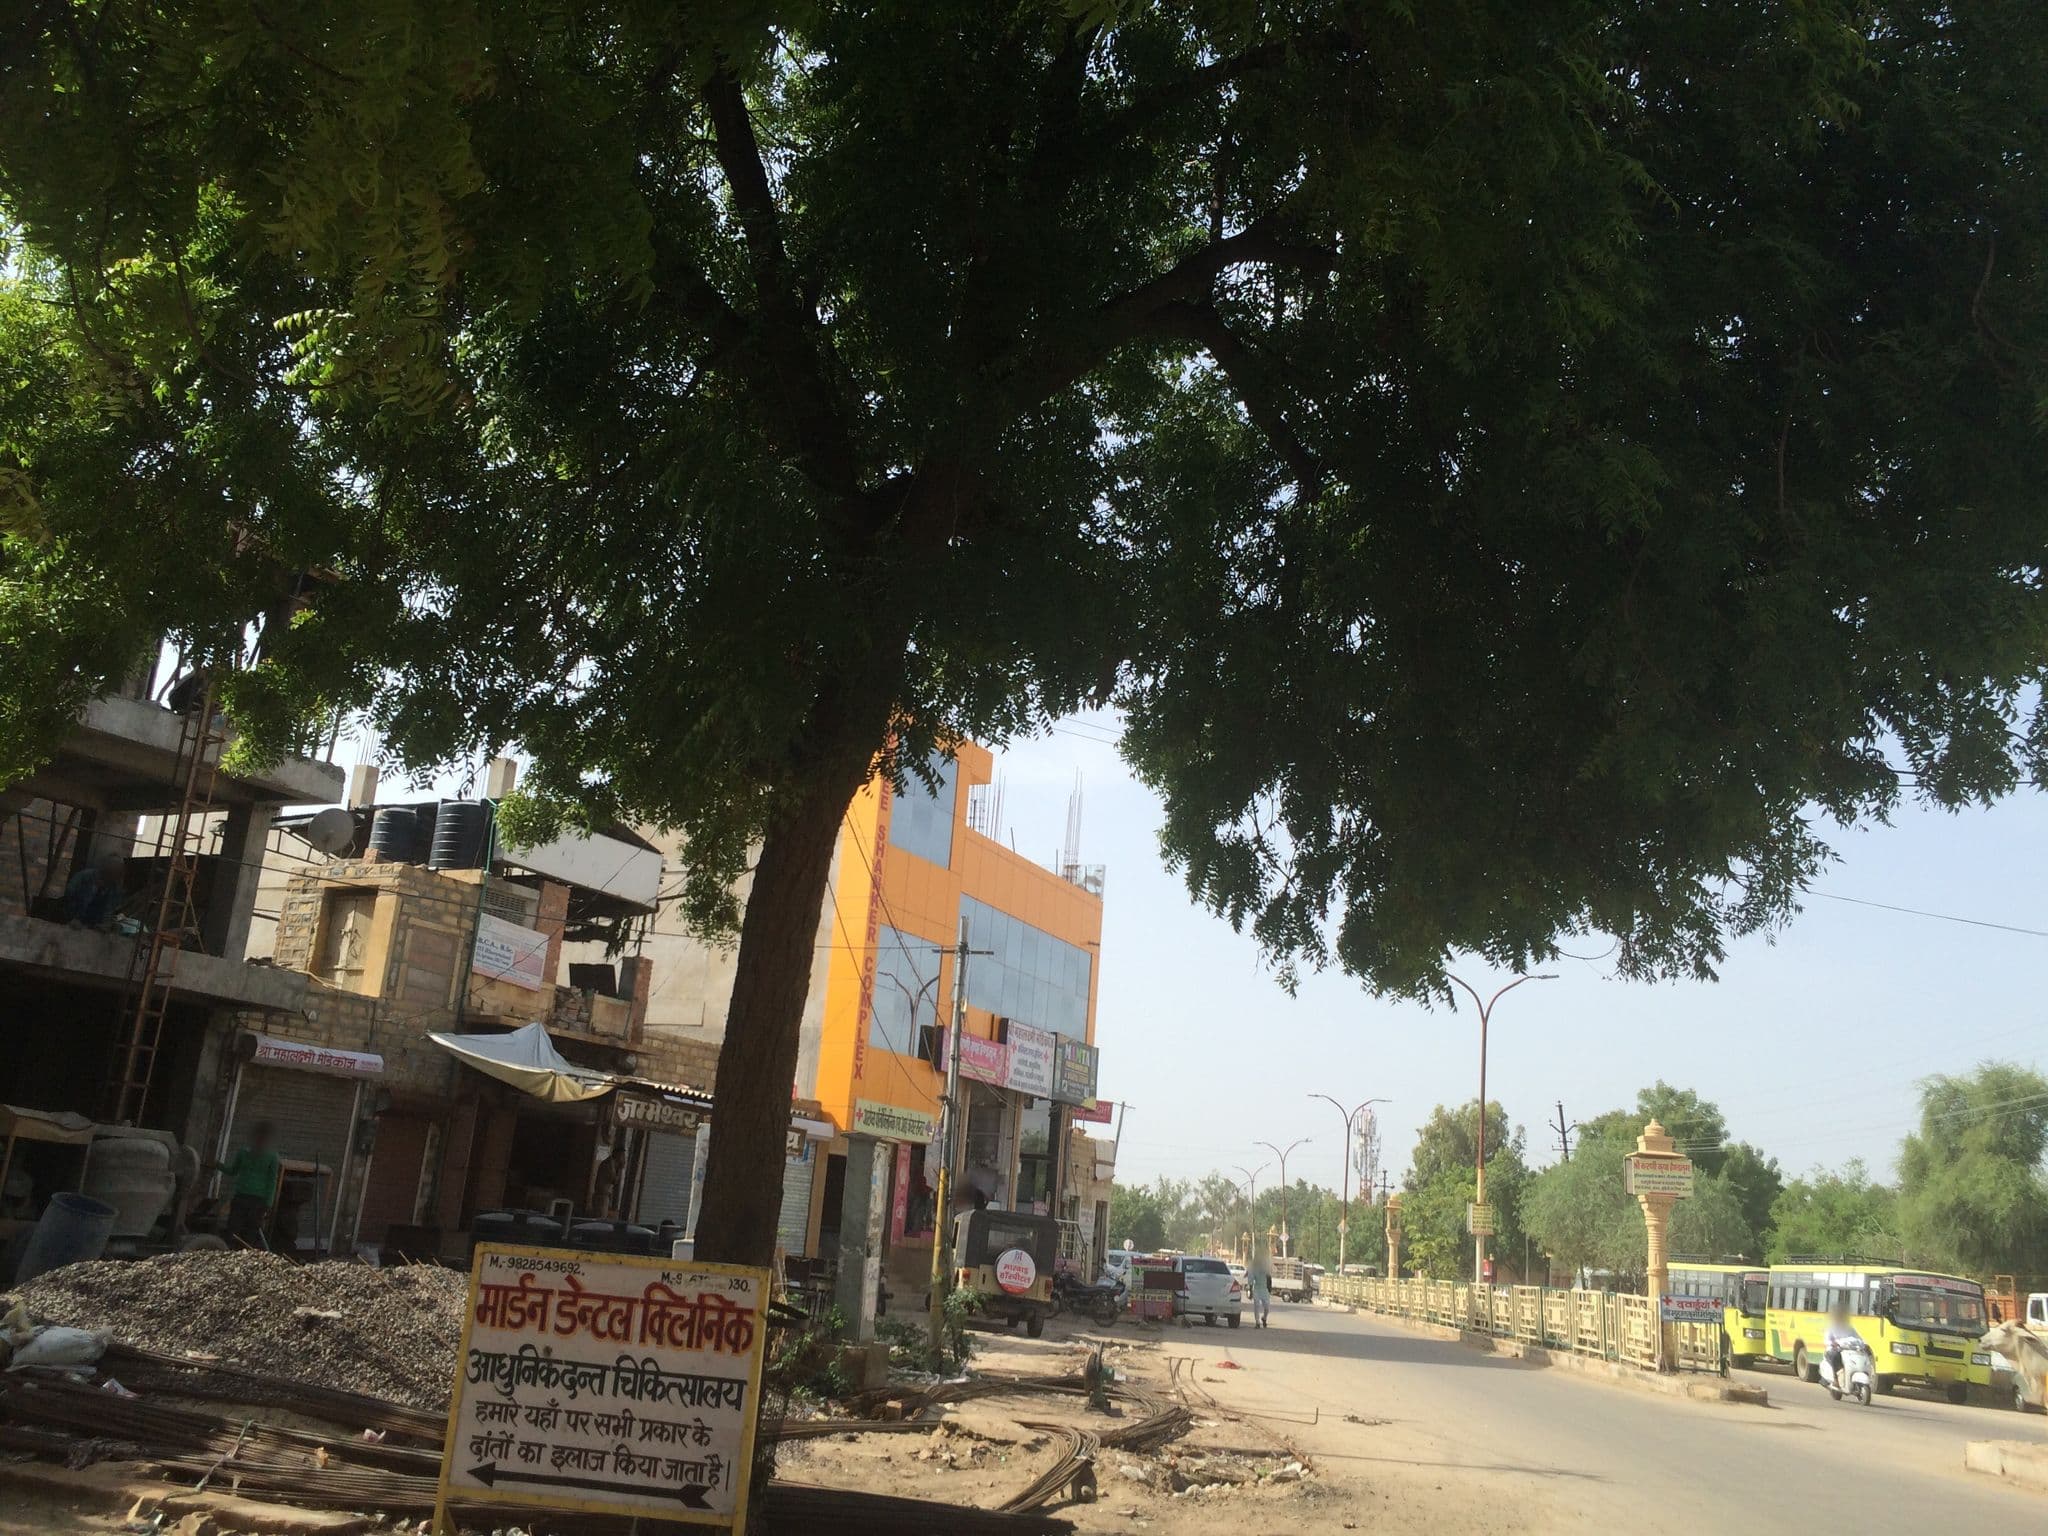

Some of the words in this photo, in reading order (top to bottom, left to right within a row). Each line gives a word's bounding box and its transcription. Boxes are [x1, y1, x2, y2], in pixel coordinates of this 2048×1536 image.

[854, 956, 873, 1080] COMPLEX
[554, 1274, 640, 1341] डेन्टल
[612, 1354, 748, 1411] चिकित्सालय
[475, 1396, 522, 1428] हमारे
[524, 1397, 562, 1433] यहाँ
[565, 1410, 593, 1436] पर
[594, 1408, 636, 1439] सभी
[638, 1418, 692, 1448] प्रकार
[692, 1417, 713, 1447] के
[469, 1430, 515, 1463] दांतों
[517, 1440, 547, 1464] का
[551, 1444, 611, 1472] इलाज
[613, 1443, 662, 1479] किया
[661, 1458, 707, 1484] जाता
